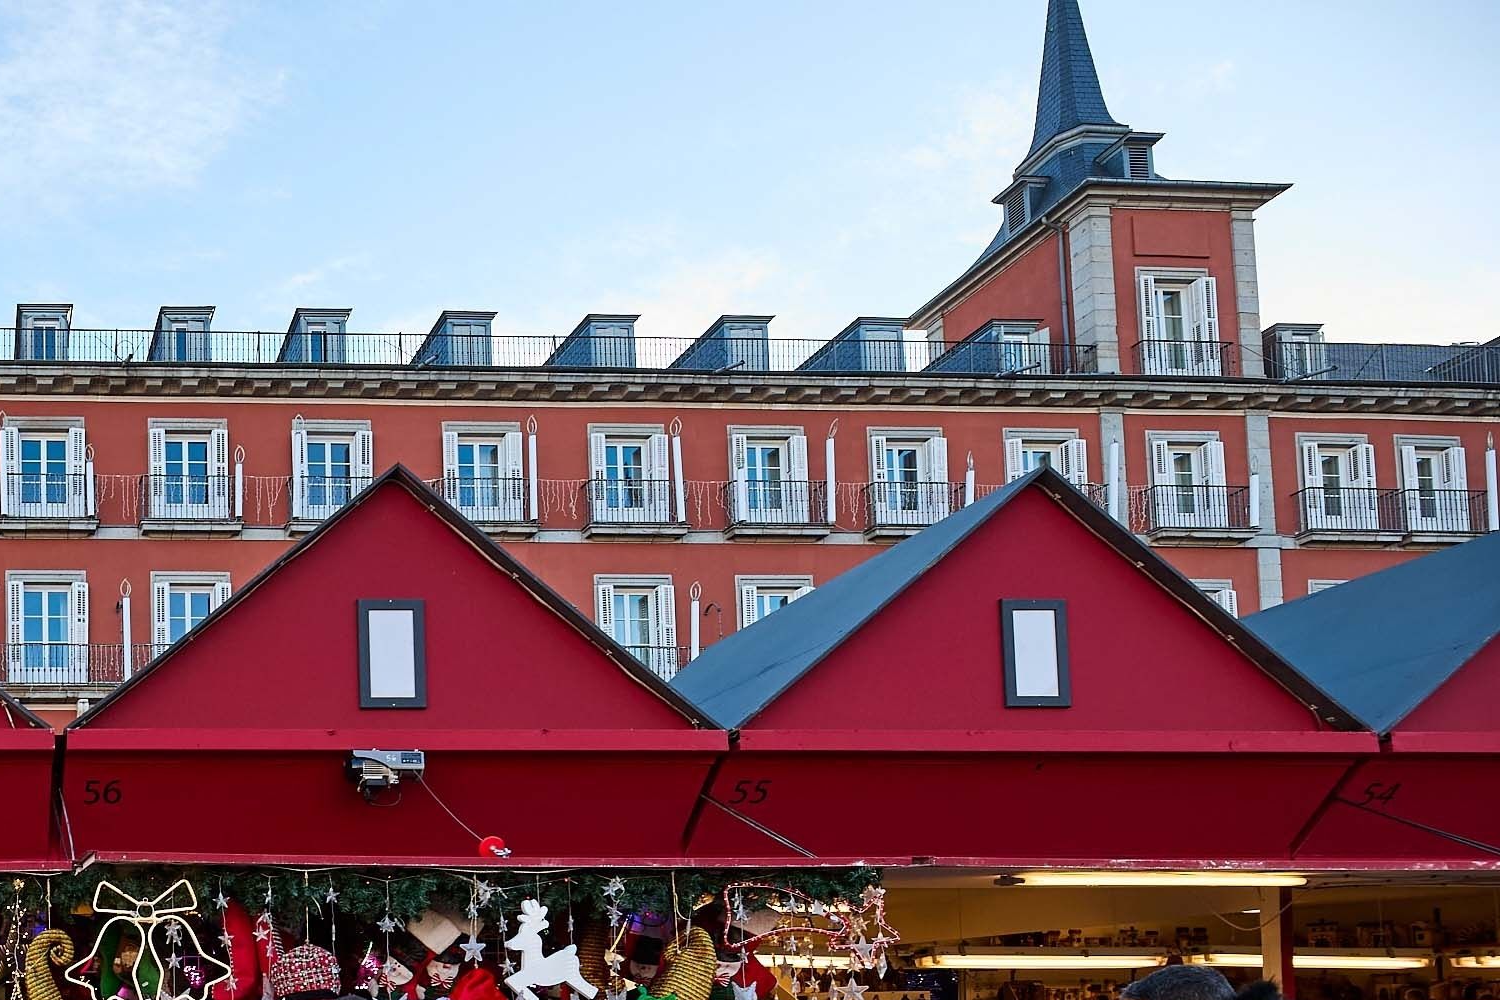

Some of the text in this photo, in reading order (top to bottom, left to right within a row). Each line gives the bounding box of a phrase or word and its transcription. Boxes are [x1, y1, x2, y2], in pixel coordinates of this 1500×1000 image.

[84, 780, 121, 804] 56
[729, 780, 772, 804] 55
[1360, 783, 1401, 805] 54
